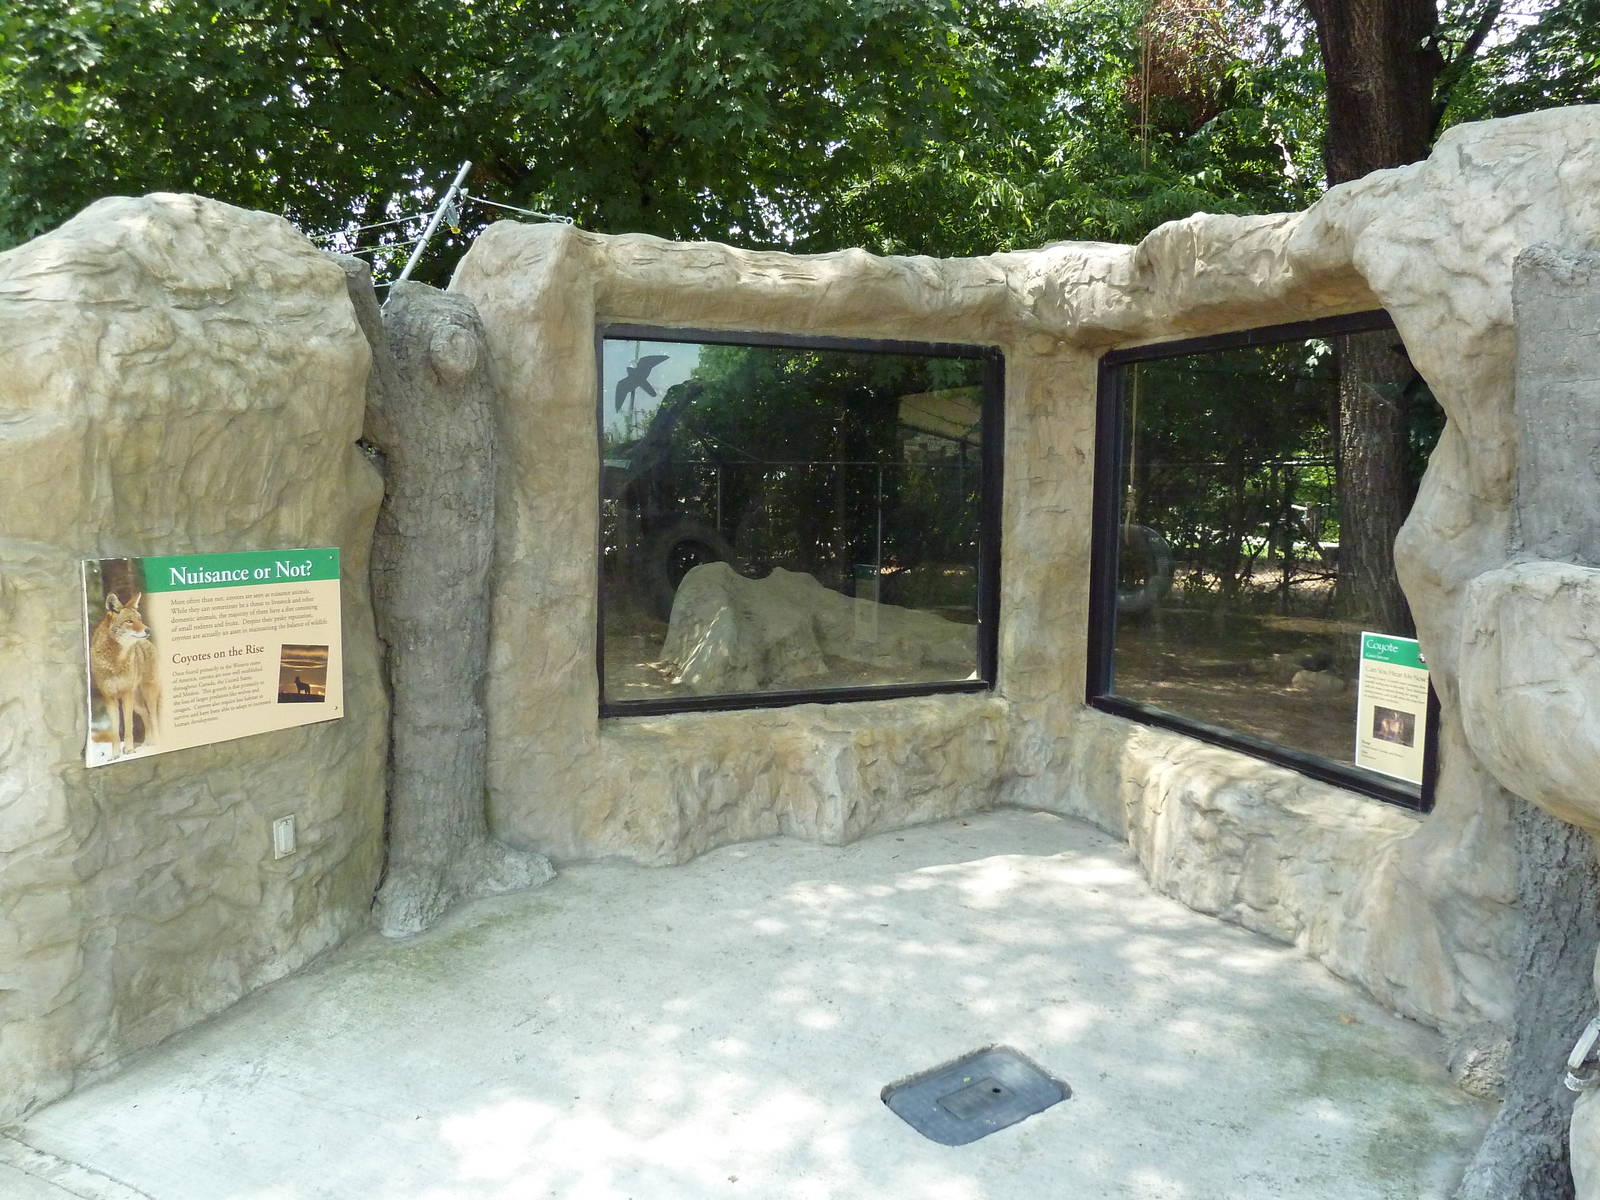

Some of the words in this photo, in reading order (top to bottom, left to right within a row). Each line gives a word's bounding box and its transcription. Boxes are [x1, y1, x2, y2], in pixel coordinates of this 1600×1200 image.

[169, 566, 250, 586] Nuisance
[253, 567, 272, 580] or
[275, 560, 313, 578] Not?
[172, 652, 211, 666] Coyotes
[213, 651, 226, 659] on
[228, 646, 243, 657] the
[245, 644, 265, 655] Rise
[1366, 639, 1399, 655] Coyote
